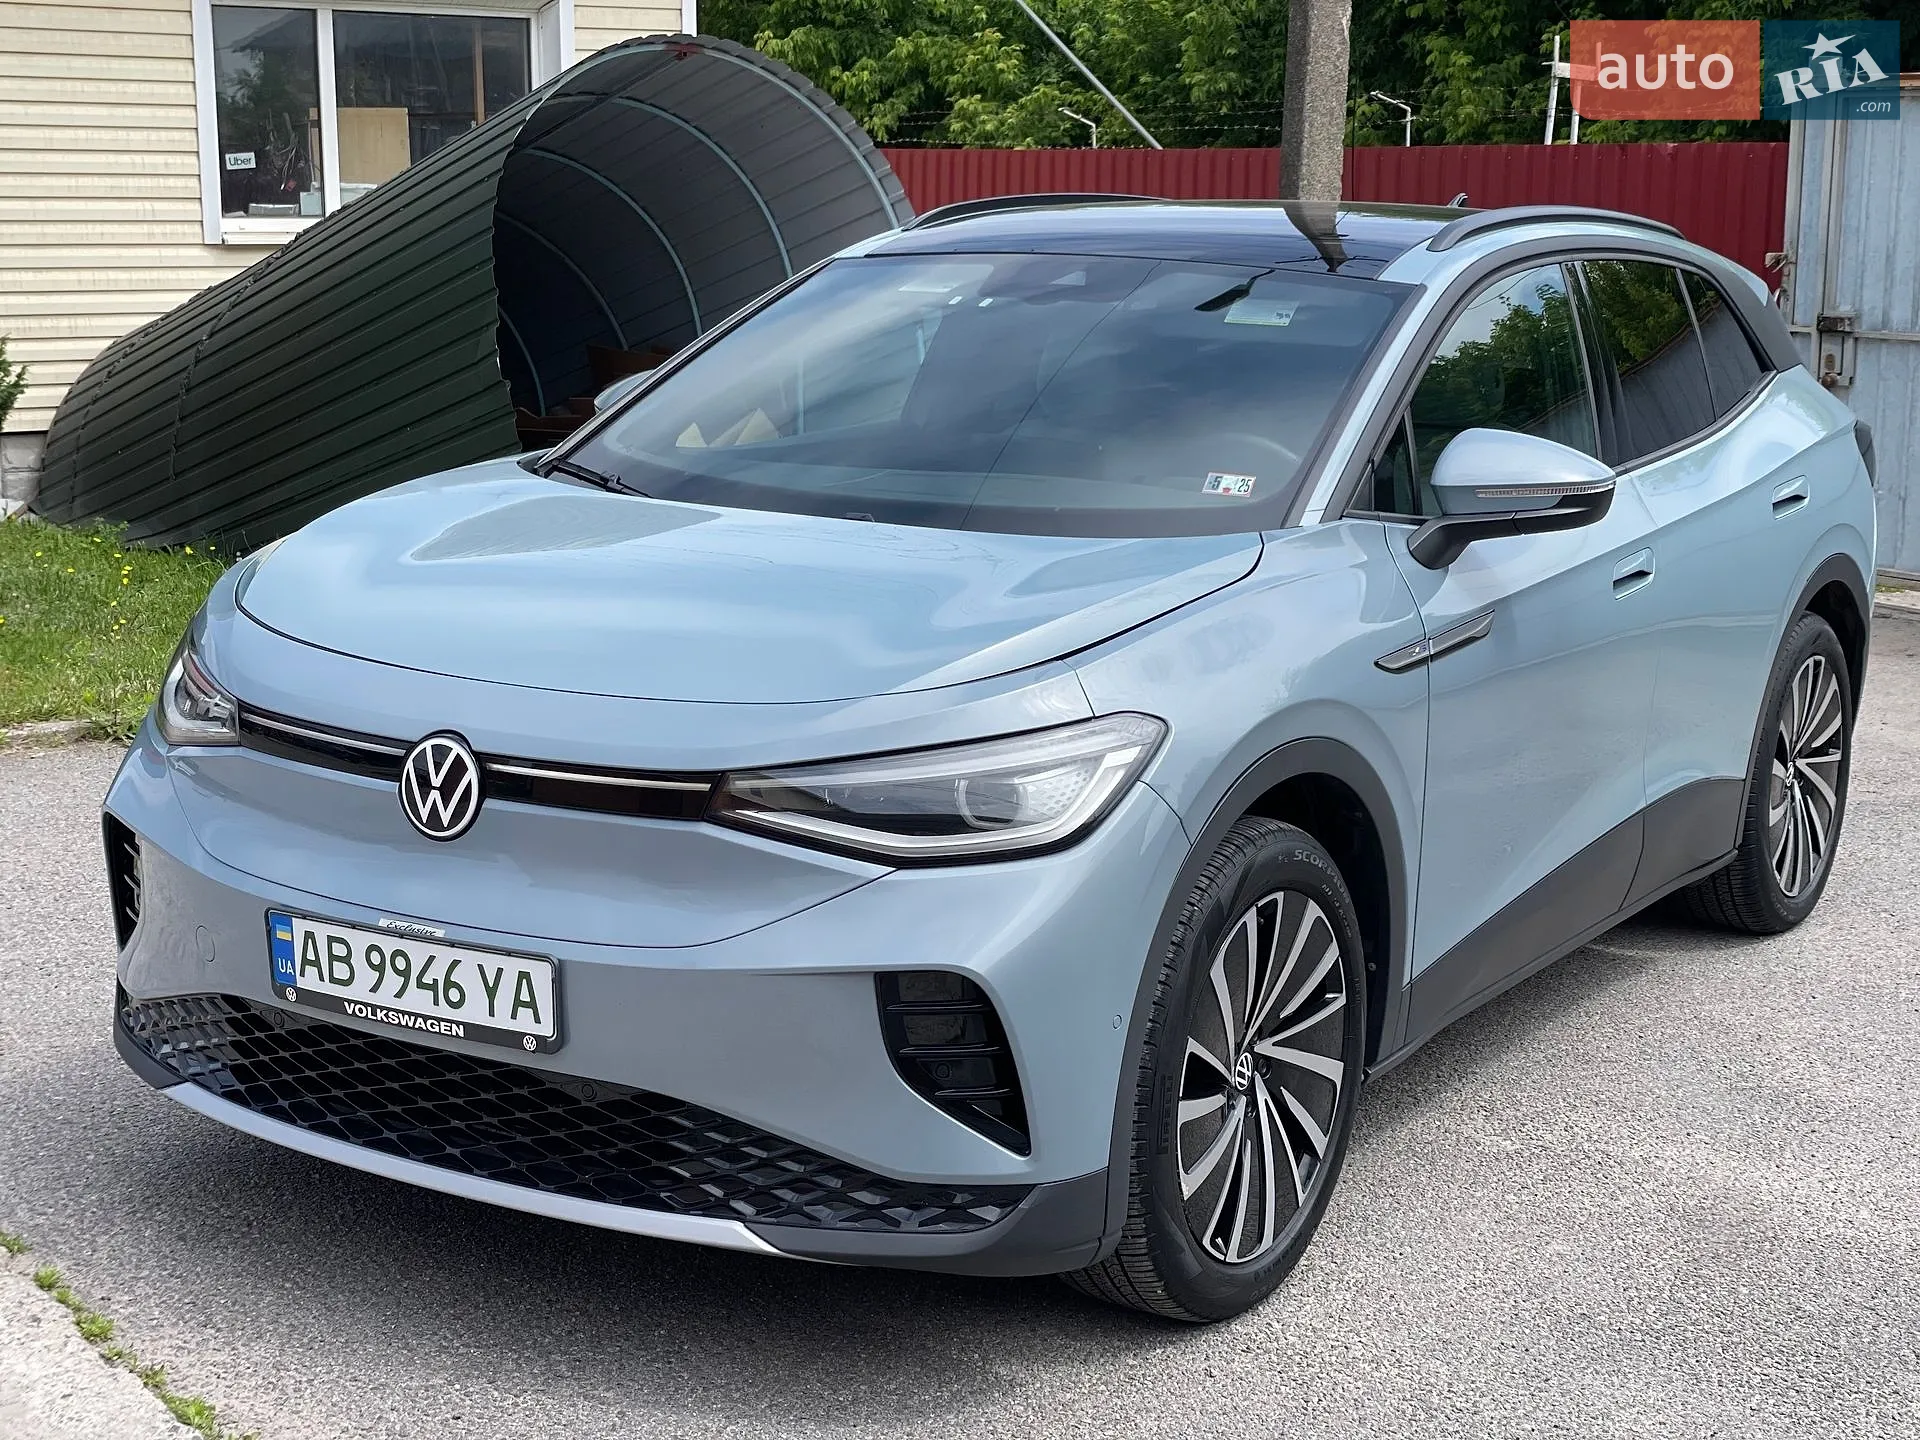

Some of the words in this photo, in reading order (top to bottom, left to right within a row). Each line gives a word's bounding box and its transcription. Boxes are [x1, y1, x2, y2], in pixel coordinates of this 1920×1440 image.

[229, 156, 252, 166] Uber
[1237, 478, 1252, 492] 25
[386, 921, 437, 936] Exclusive
[278, 957, 295, 976] UA
[299, 930, 356, 988] AB
[364, 943, 467, 1011] 9946
[477, 963, 542, 1025] YA
[343, 1001, 465, 1038] VOLKSWAGEN
